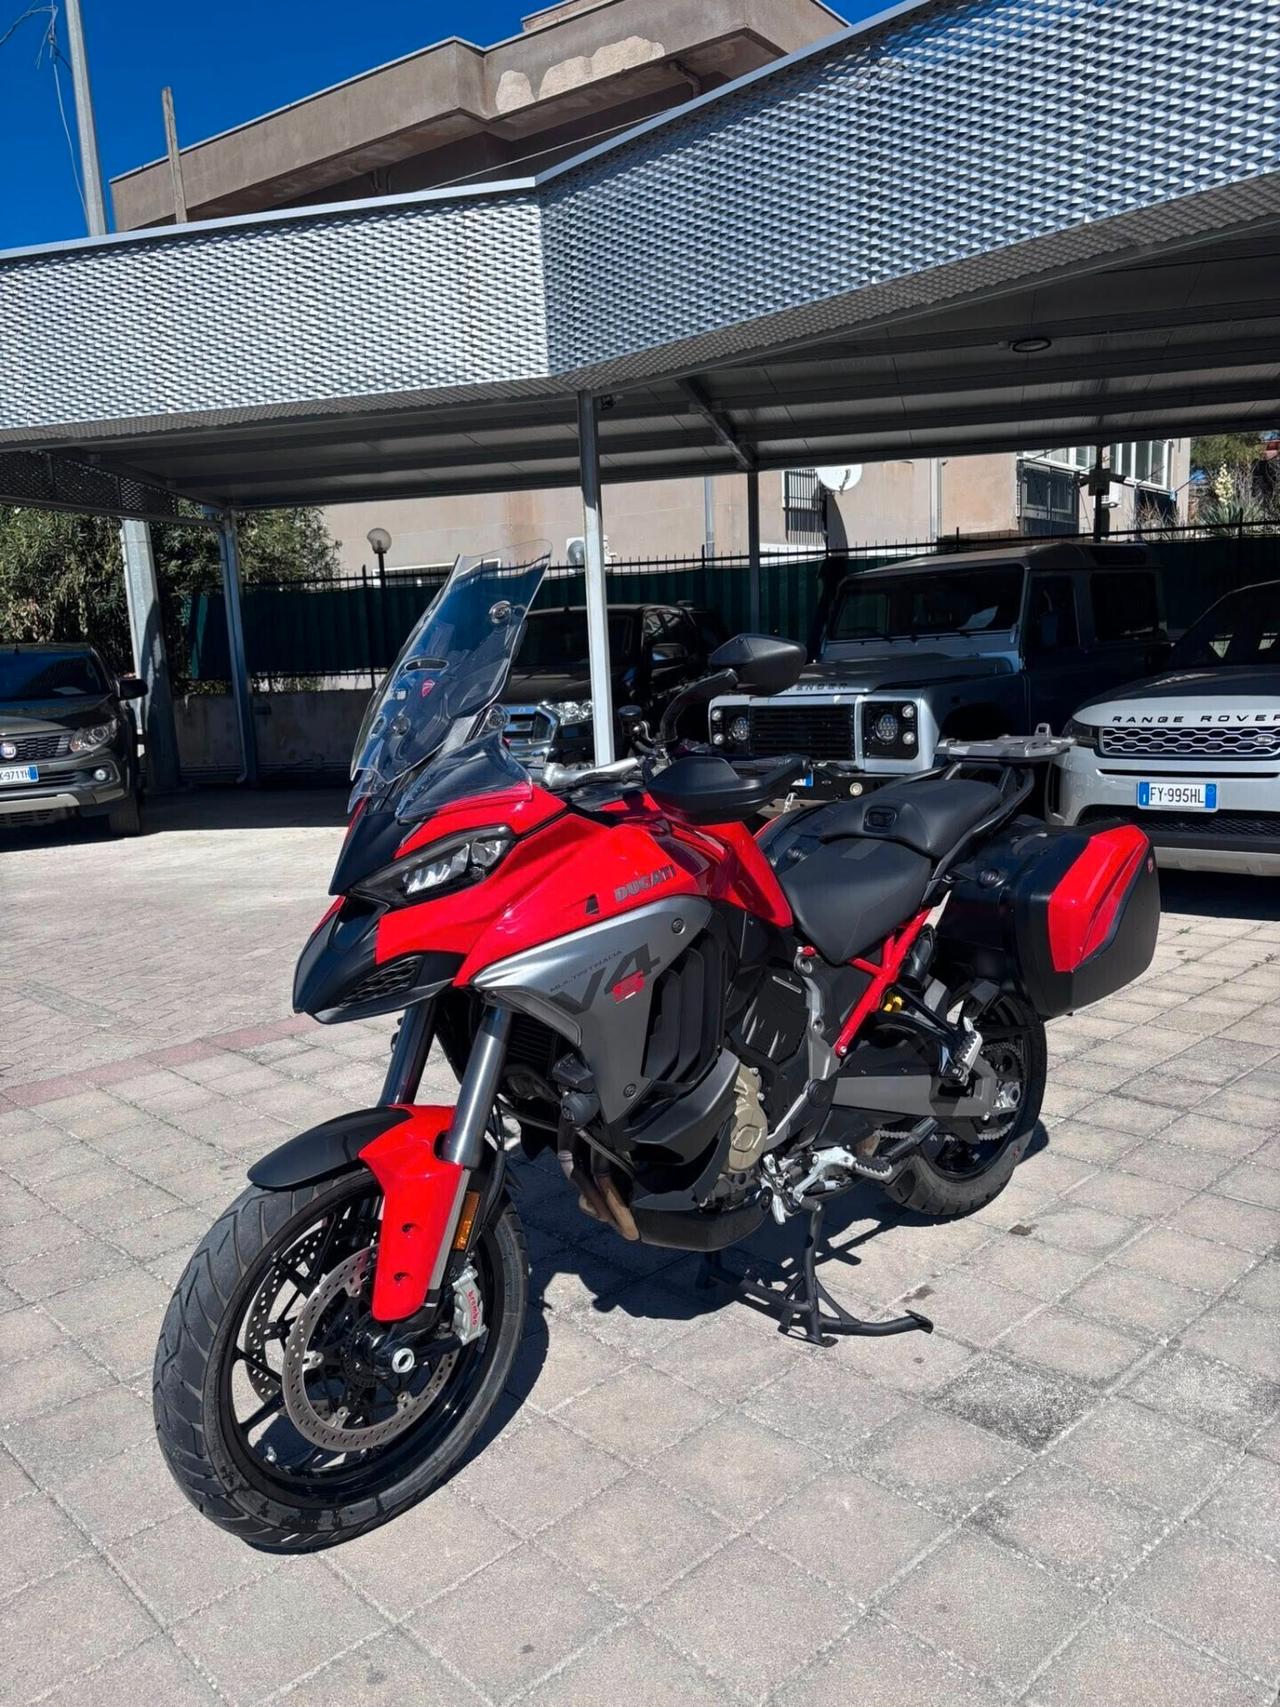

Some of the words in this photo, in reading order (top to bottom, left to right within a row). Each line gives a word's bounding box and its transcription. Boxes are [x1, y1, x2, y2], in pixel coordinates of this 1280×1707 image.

[1111, 715, 1185, 724] RANGE
[613, 864, 676, 903] DUCATI
[466, 1289, 480, 1329] brembo
